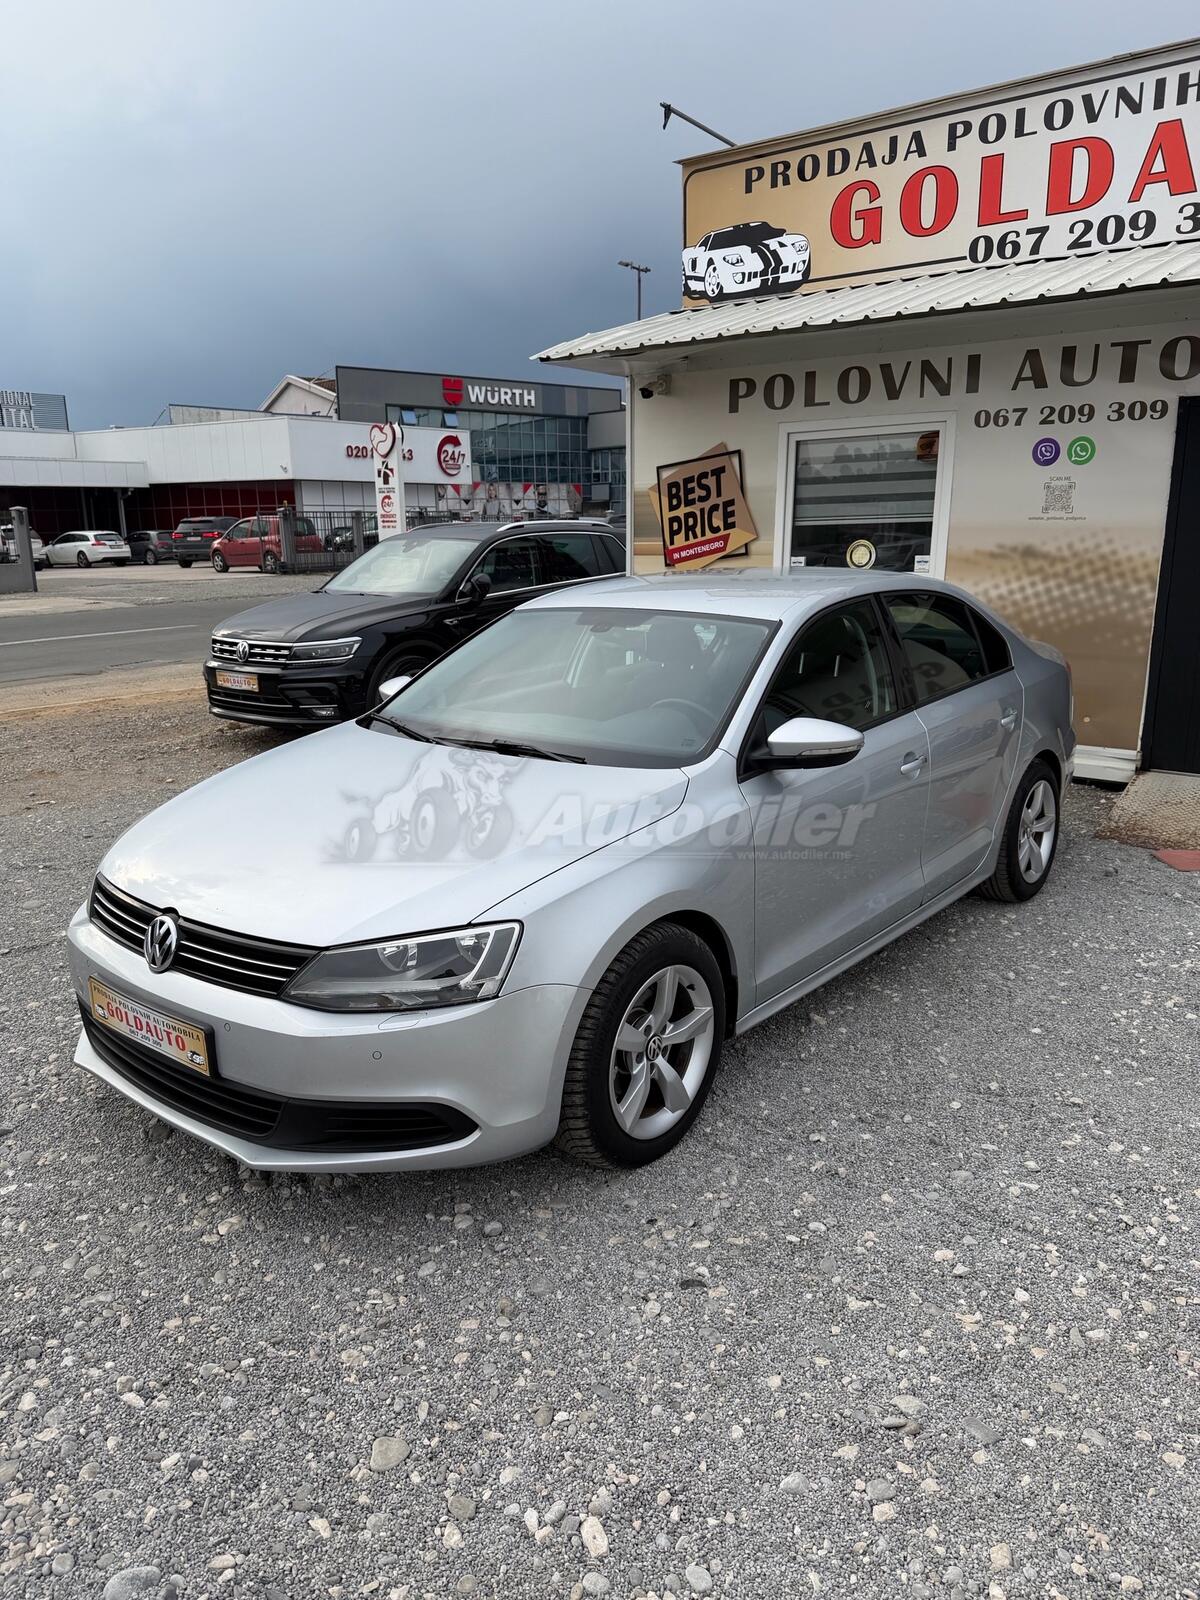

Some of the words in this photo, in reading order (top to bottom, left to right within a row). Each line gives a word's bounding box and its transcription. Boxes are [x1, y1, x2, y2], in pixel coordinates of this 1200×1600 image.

[744, 130, 927, 194] PRODAJA
[947, 70, 1200, 153] POLOVNIH
[829, 118, 1198, 249] GOLDA
[968, 225, 1050, 264] 067
[1066, 209, 1157, 248] 209
[728, 353, 982, 414] POLOVNI
[1011, 335, 1200, 391] AUTO
[974, 407, 1028, 428] 067
[1038, 403, 1096, 426] 209
[1107, 400, 1168, 422] 309
[346, 445, 368, 458] 020
[442, 450, 465, 464] 24/7
[667, 465, 726, 512] BEST
[668, 498, 736, 546] PRICE
[673, 552, 680, 560] IN
[680, 540, 724, 558] MONTENEGRO
[222, 677, 251, 686] GOLDAUTO
[107, 1001, 185, 1052] GOLDAUTO
[152, 1016, 201, 1042] AUTOMOBILA
